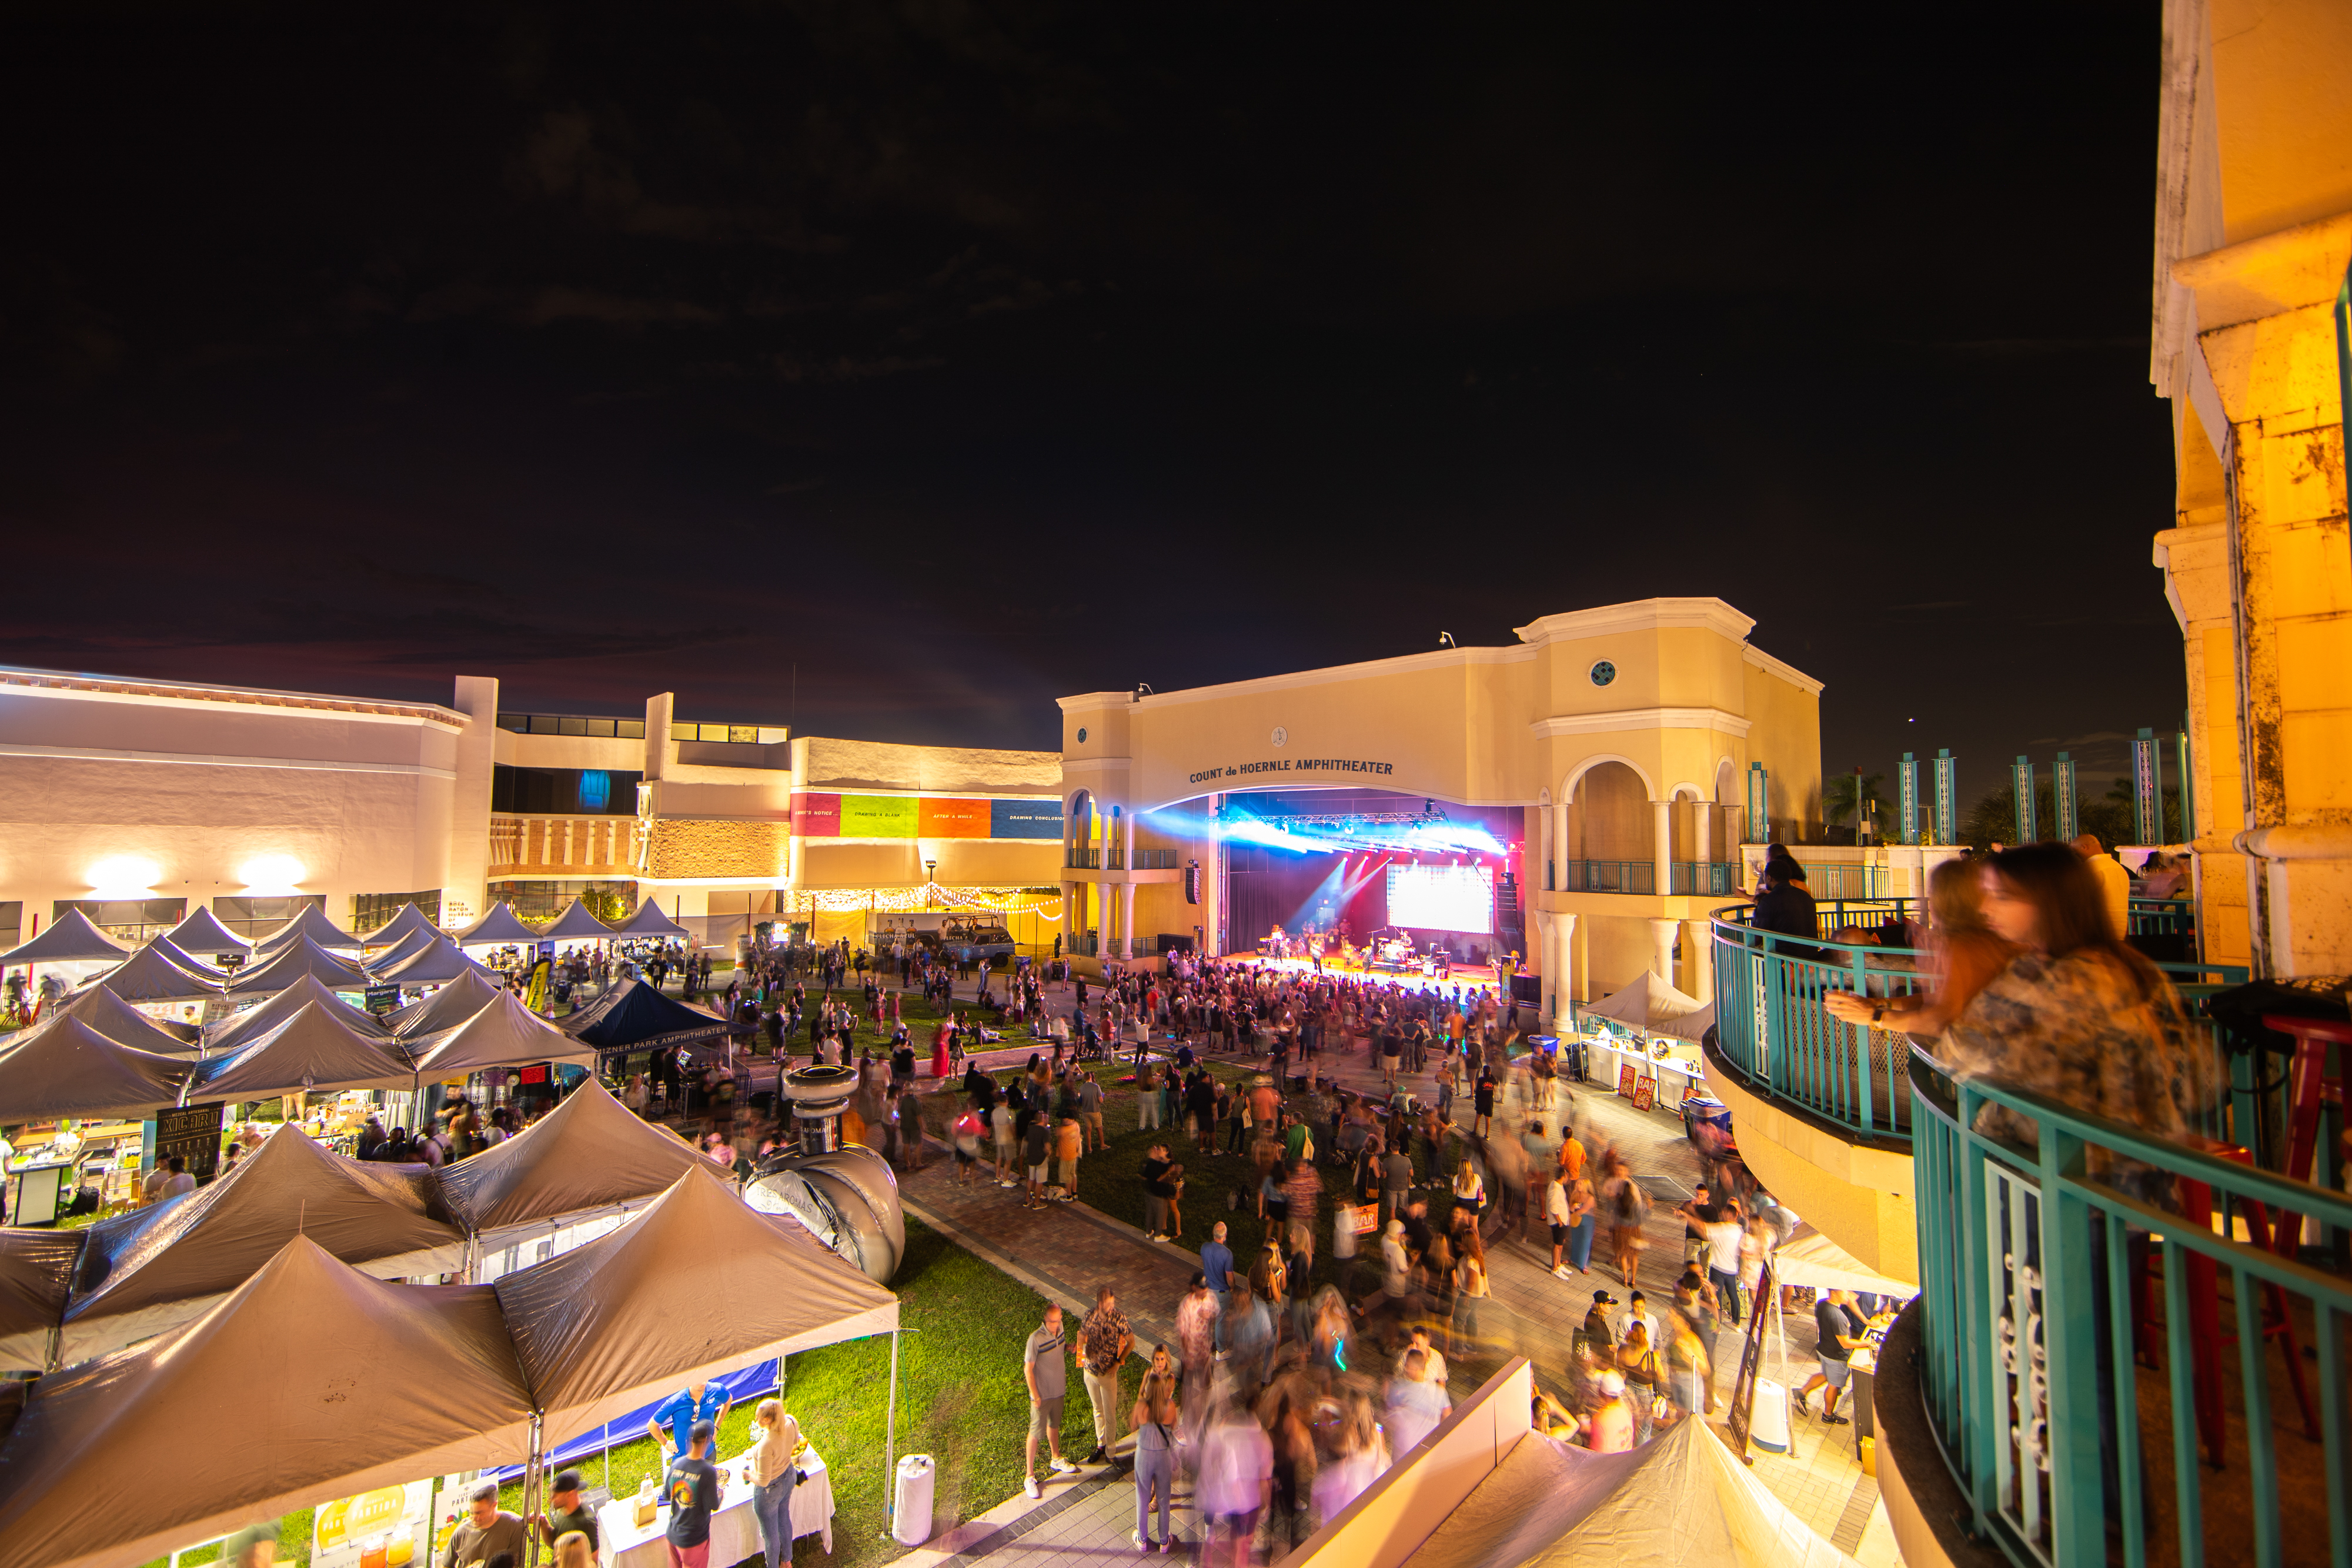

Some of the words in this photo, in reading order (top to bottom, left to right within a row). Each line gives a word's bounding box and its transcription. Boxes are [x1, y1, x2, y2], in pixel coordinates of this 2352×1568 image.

[1190, 767, 1223, 784] COUNT
[1225, 766, 1237, 776] de
[1240, 760, 1291, 774] HOERNLE
[1295, 759, 1393, 775] AMPHITHEATER
[634, 1039, 657, 1049] PARK
[661, 1026, 727, 1045] AMPHITHEATER
[1638, 1077, 1656, 1092] BAR
[162, 1111, 218, 1134] XICARU
[756, 1186, 777, 1198] TRES
[779, 1191, 813, 1213] AROMAS
[1353, 1213, 1374, 1228] BAR
[1735, 1405, 1746, 1437] GHOST
[353, 1498, 396, 1521] PARTIDA
